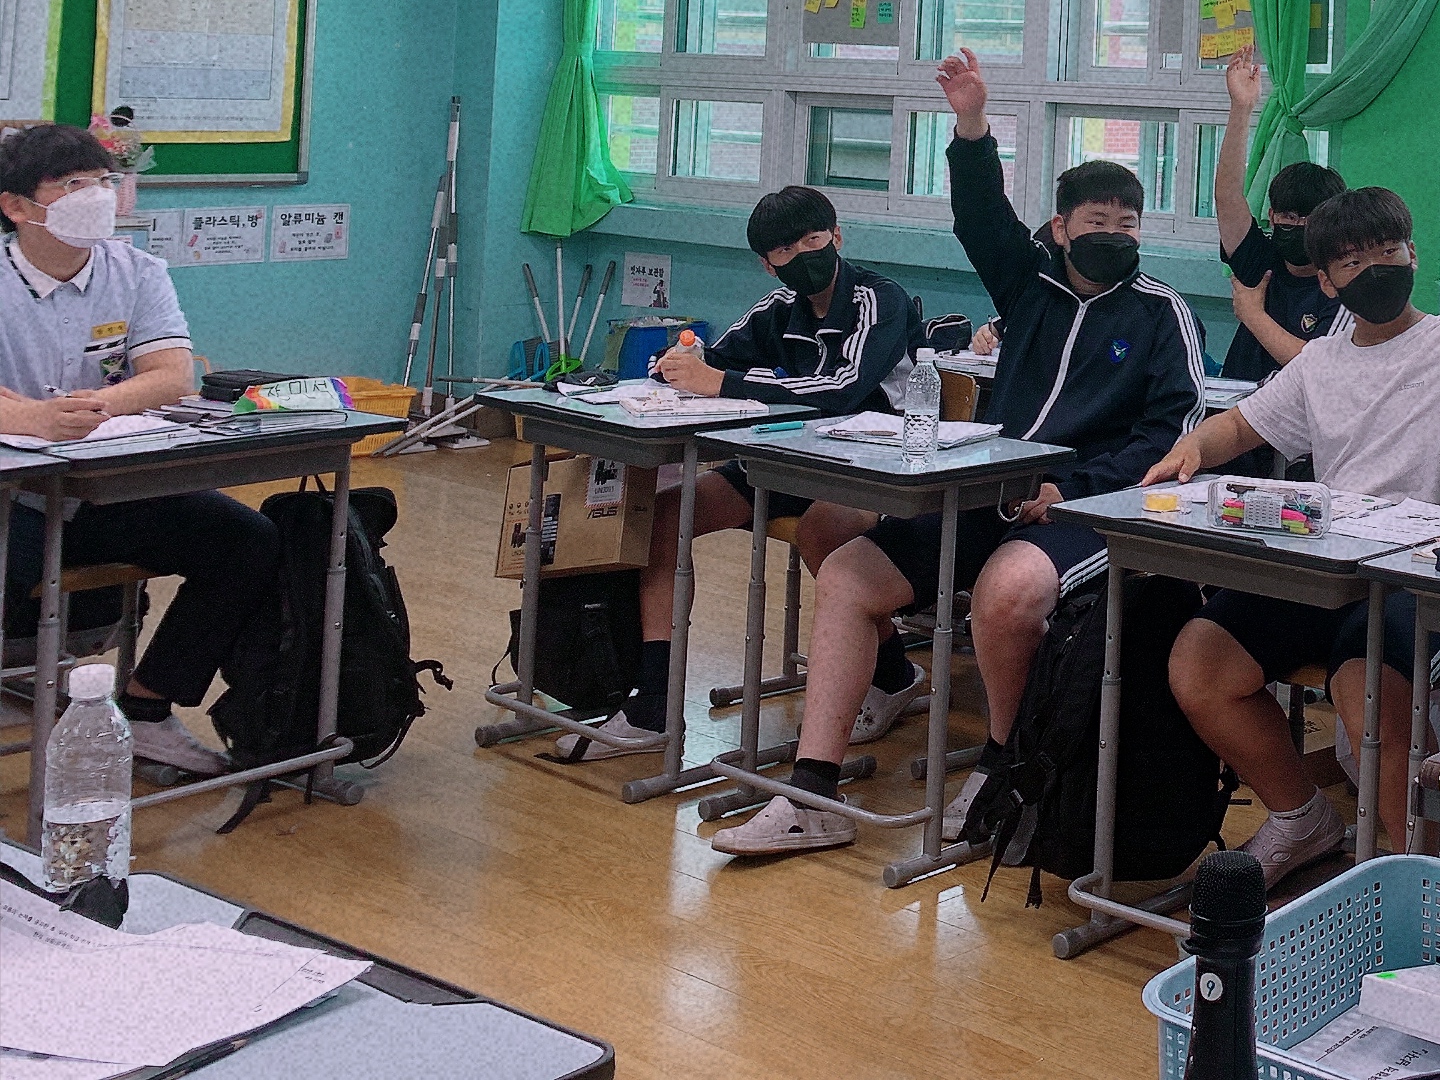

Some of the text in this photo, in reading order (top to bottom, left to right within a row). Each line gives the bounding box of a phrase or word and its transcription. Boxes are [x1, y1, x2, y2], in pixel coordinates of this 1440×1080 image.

[333, 211, 344, 226] 캔
[630, 265, 664, 278] 빗자루 보관함
[587, 506, 618, 520] ASUS
[1206, 979, 1216, 998] 9
